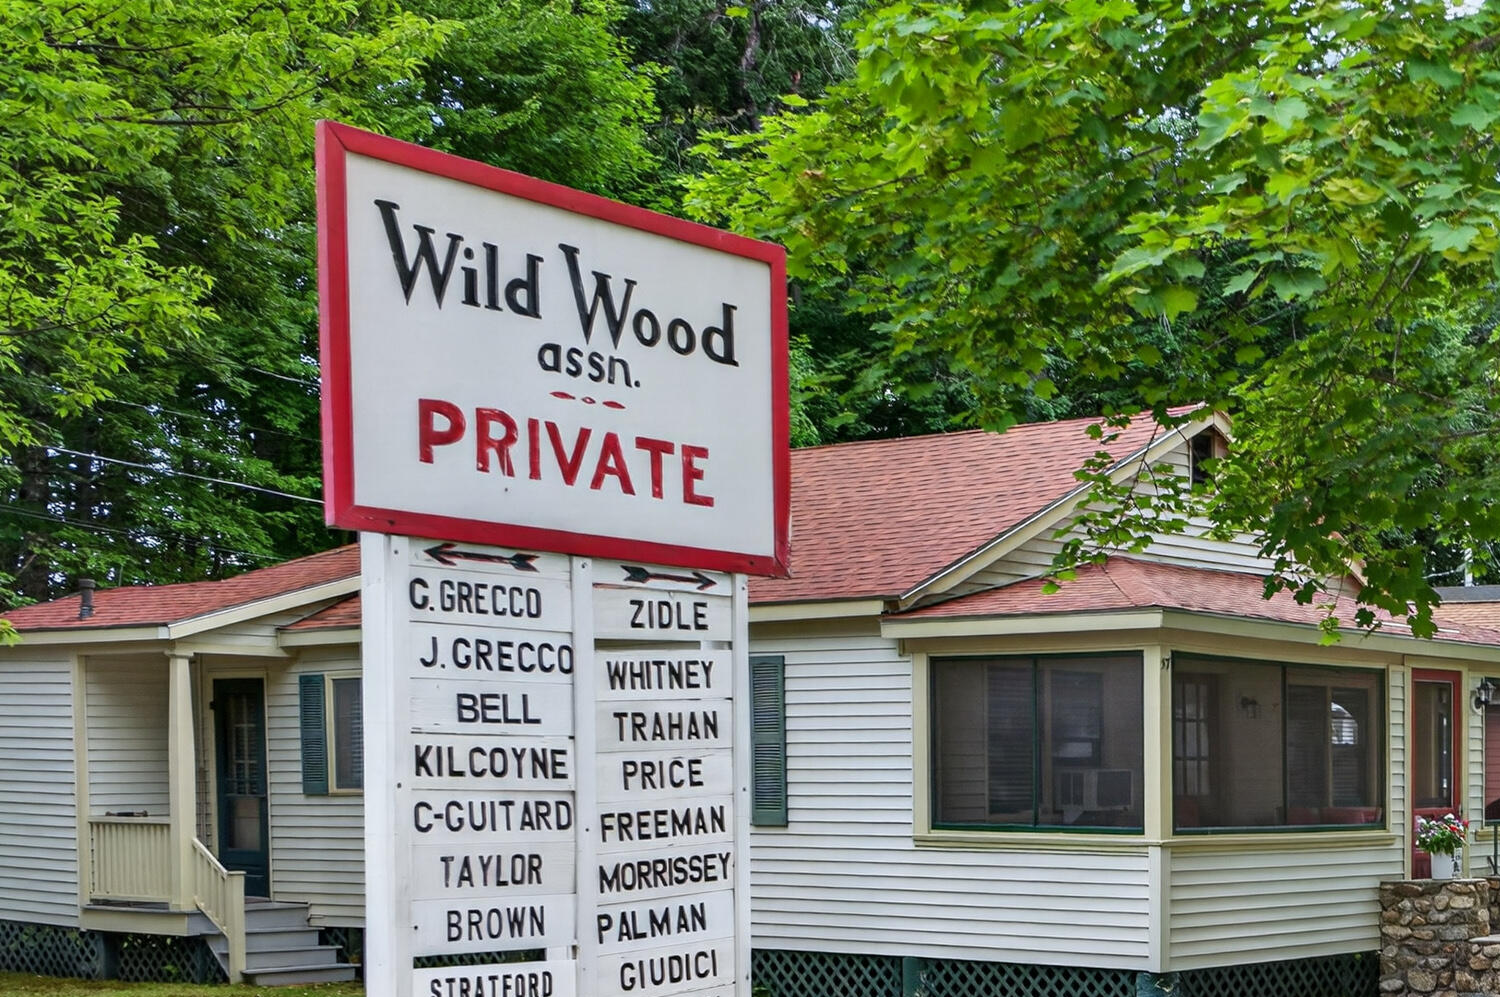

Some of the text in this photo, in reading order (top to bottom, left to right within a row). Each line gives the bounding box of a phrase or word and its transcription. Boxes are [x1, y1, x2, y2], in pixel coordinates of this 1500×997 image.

[374, 199, 740, 367] Wild Wood
[537, 342, 641, 388] assn.
[418, 398, 715, 507] PRIVATE
[439, 579, 542, 619] GRECCO
[629, 599, 709, 631] ZIDLE
[419, 636, 574, 675] J. GRECCO
[606, 660, 714, 691] WHITNEY
[456, 693, 542, 725] BELL
[612, 710, 719, 742] TRAHAN
[414, 744, 569, 780] KILCOYNE
[622, 758, 704, 791] PRICE
[414, 800, 573, 833] C-GUITARD
[600, 805, 726, 843] FREEMAN
[440, 853, 543, 888] TAYLOR
[598, 852, 731, 894] MORRISSEY
[447, 905, 545, 942] BROWN
[597, 902, 707, 945] PALMAN
[620, 949, 718, 992] GIUDICI
